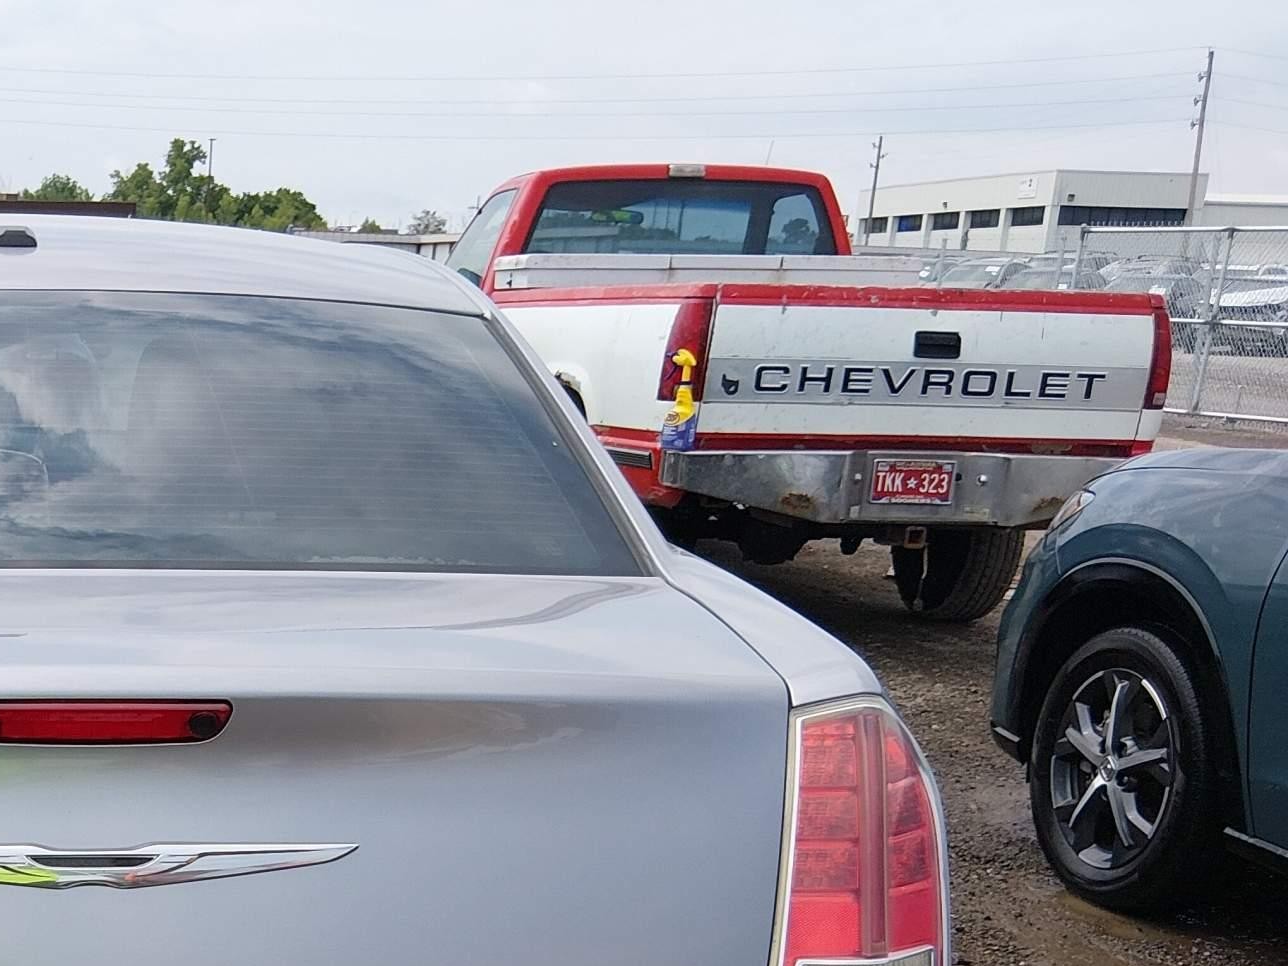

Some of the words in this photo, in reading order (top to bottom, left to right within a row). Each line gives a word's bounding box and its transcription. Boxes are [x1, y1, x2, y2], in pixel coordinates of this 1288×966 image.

[754, 364, 1107, 400] CHEVROLET
[876, 472, 905, 492] TKK
[918, 473, 949, 494] 323
